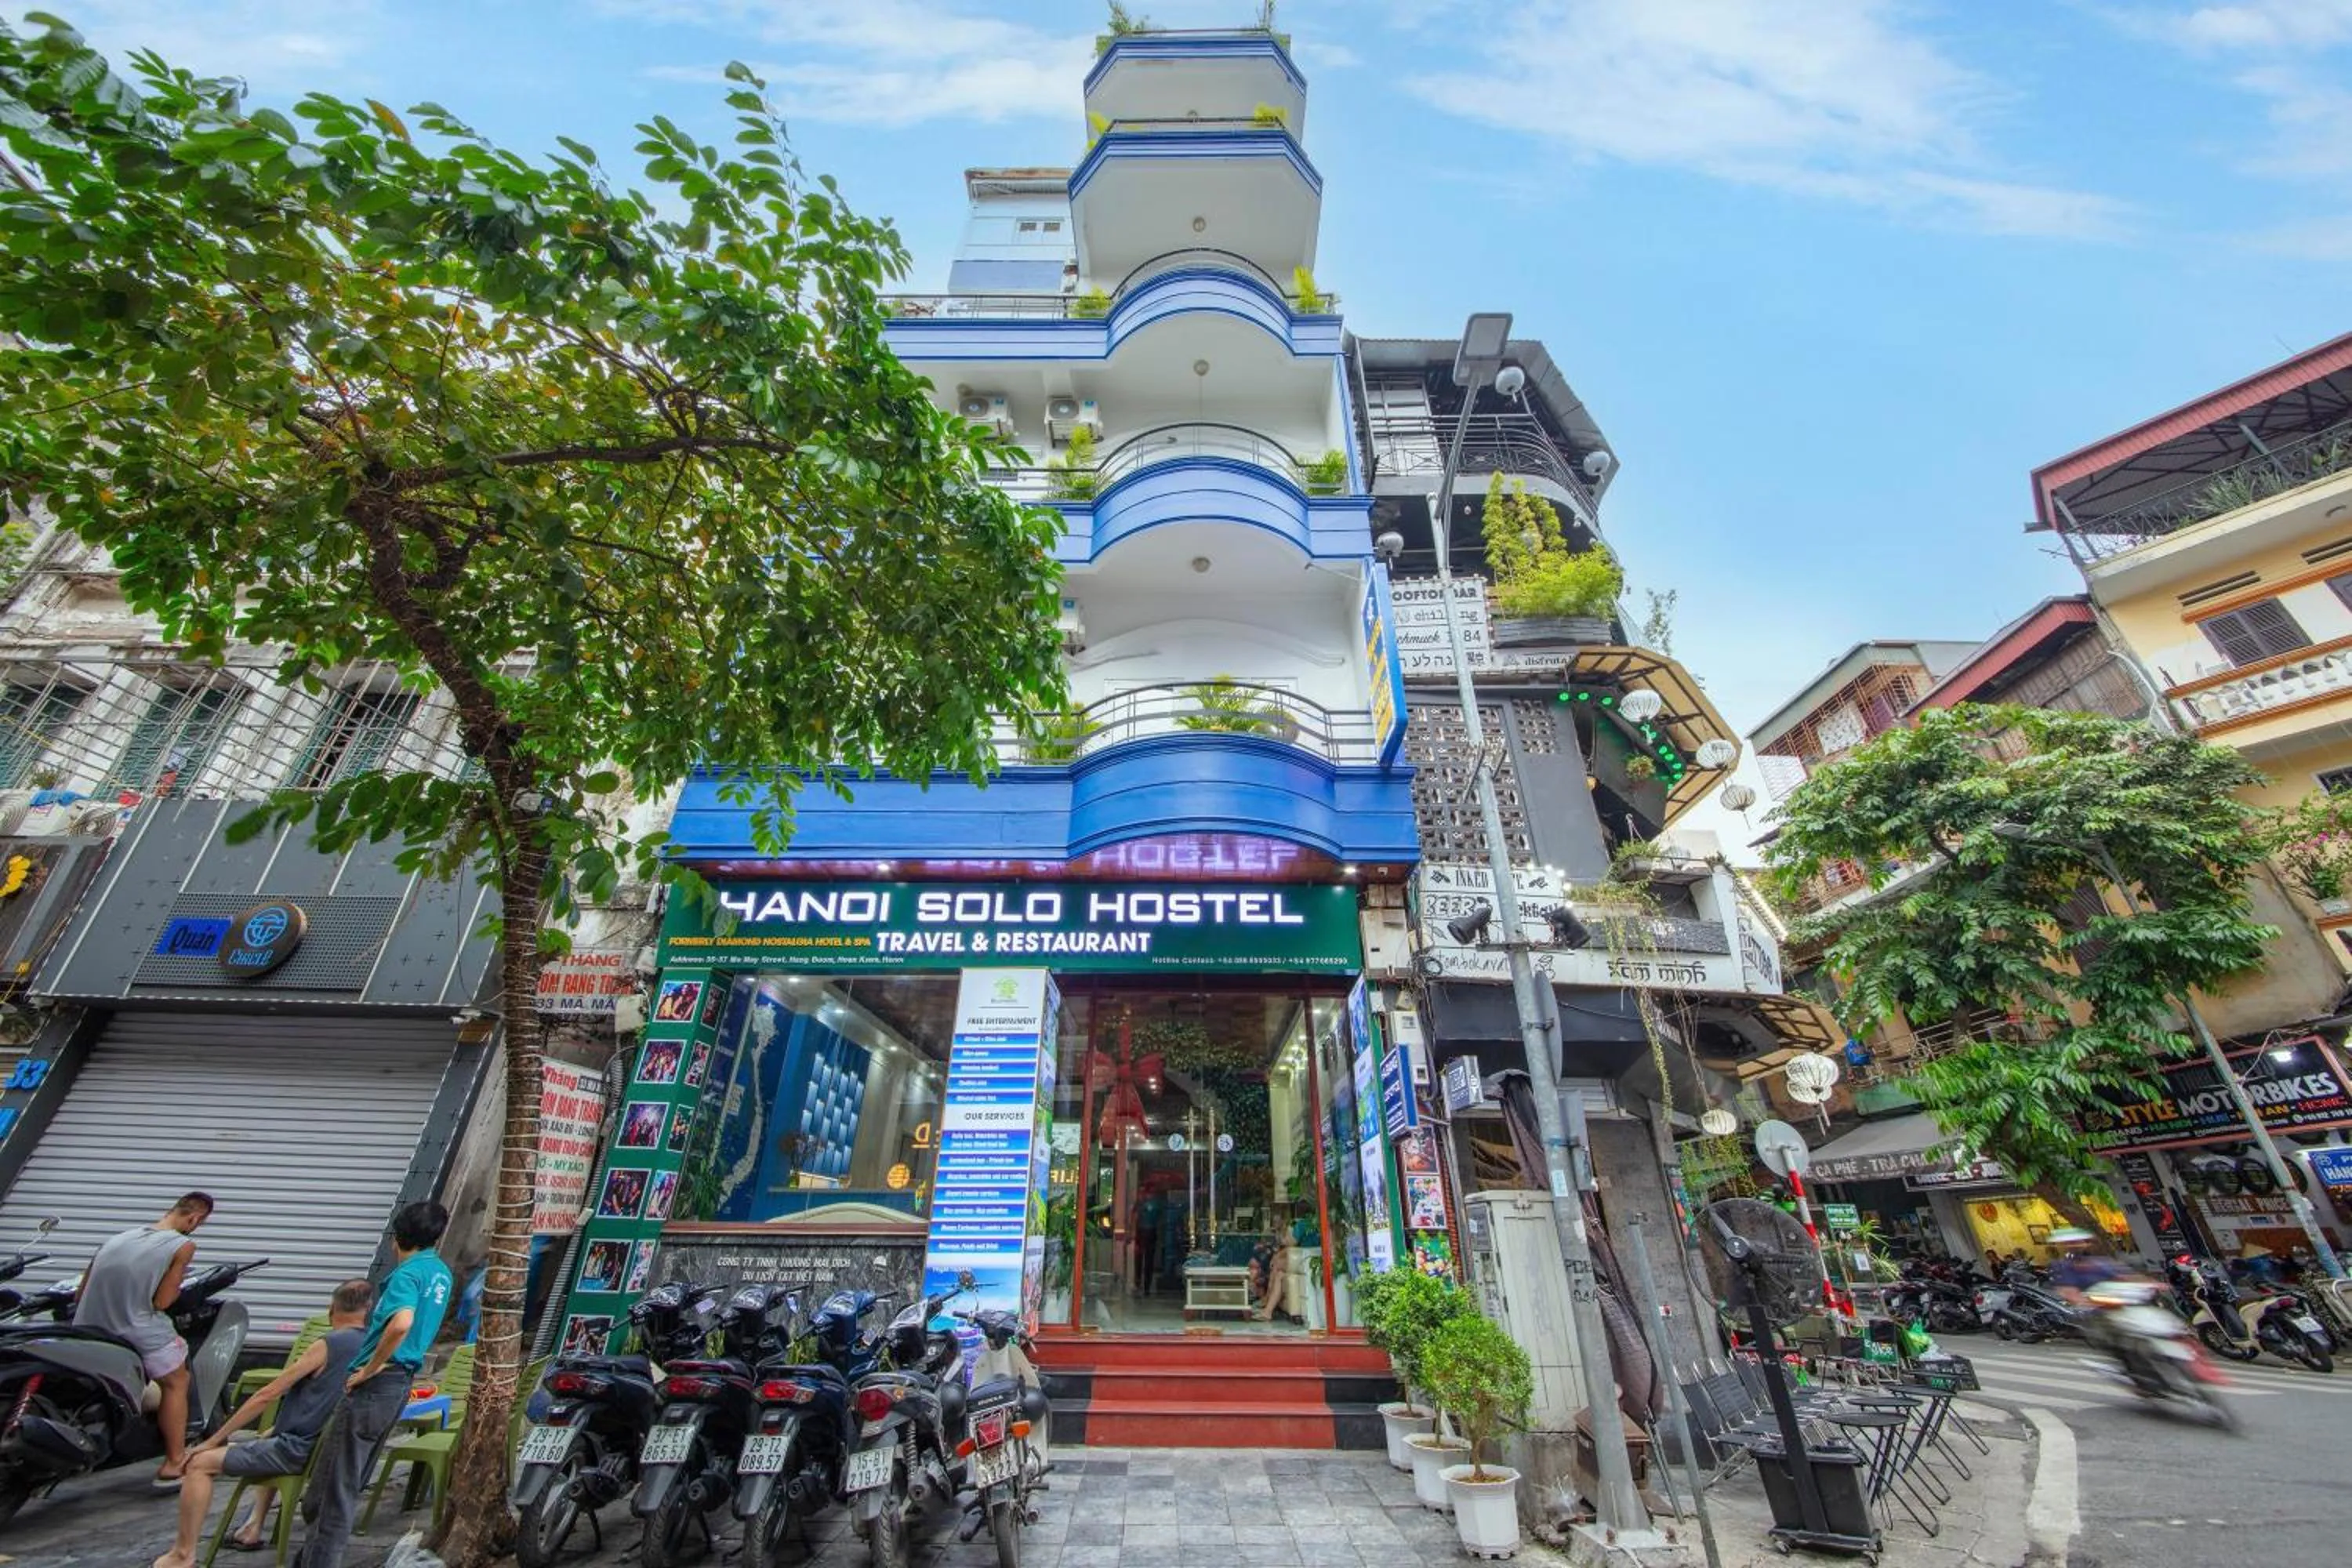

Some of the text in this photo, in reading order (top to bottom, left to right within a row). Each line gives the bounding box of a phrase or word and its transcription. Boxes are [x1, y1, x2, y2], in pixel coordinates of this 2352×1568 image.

[1391, 589, 1444, 601] OOFTO
[720, 891, 1305, 924] HANOI SOLO HOSTEL
[815, 936, 843, 947] HOTEL
[877, 931, 1152, 953] TRAVEL & RESTAURANT
[5, 1058, 49, 1091] 33
[532, 1427, 569, 1443] 29-Y7
[750, 1436, 782, 1454] 29-T2
